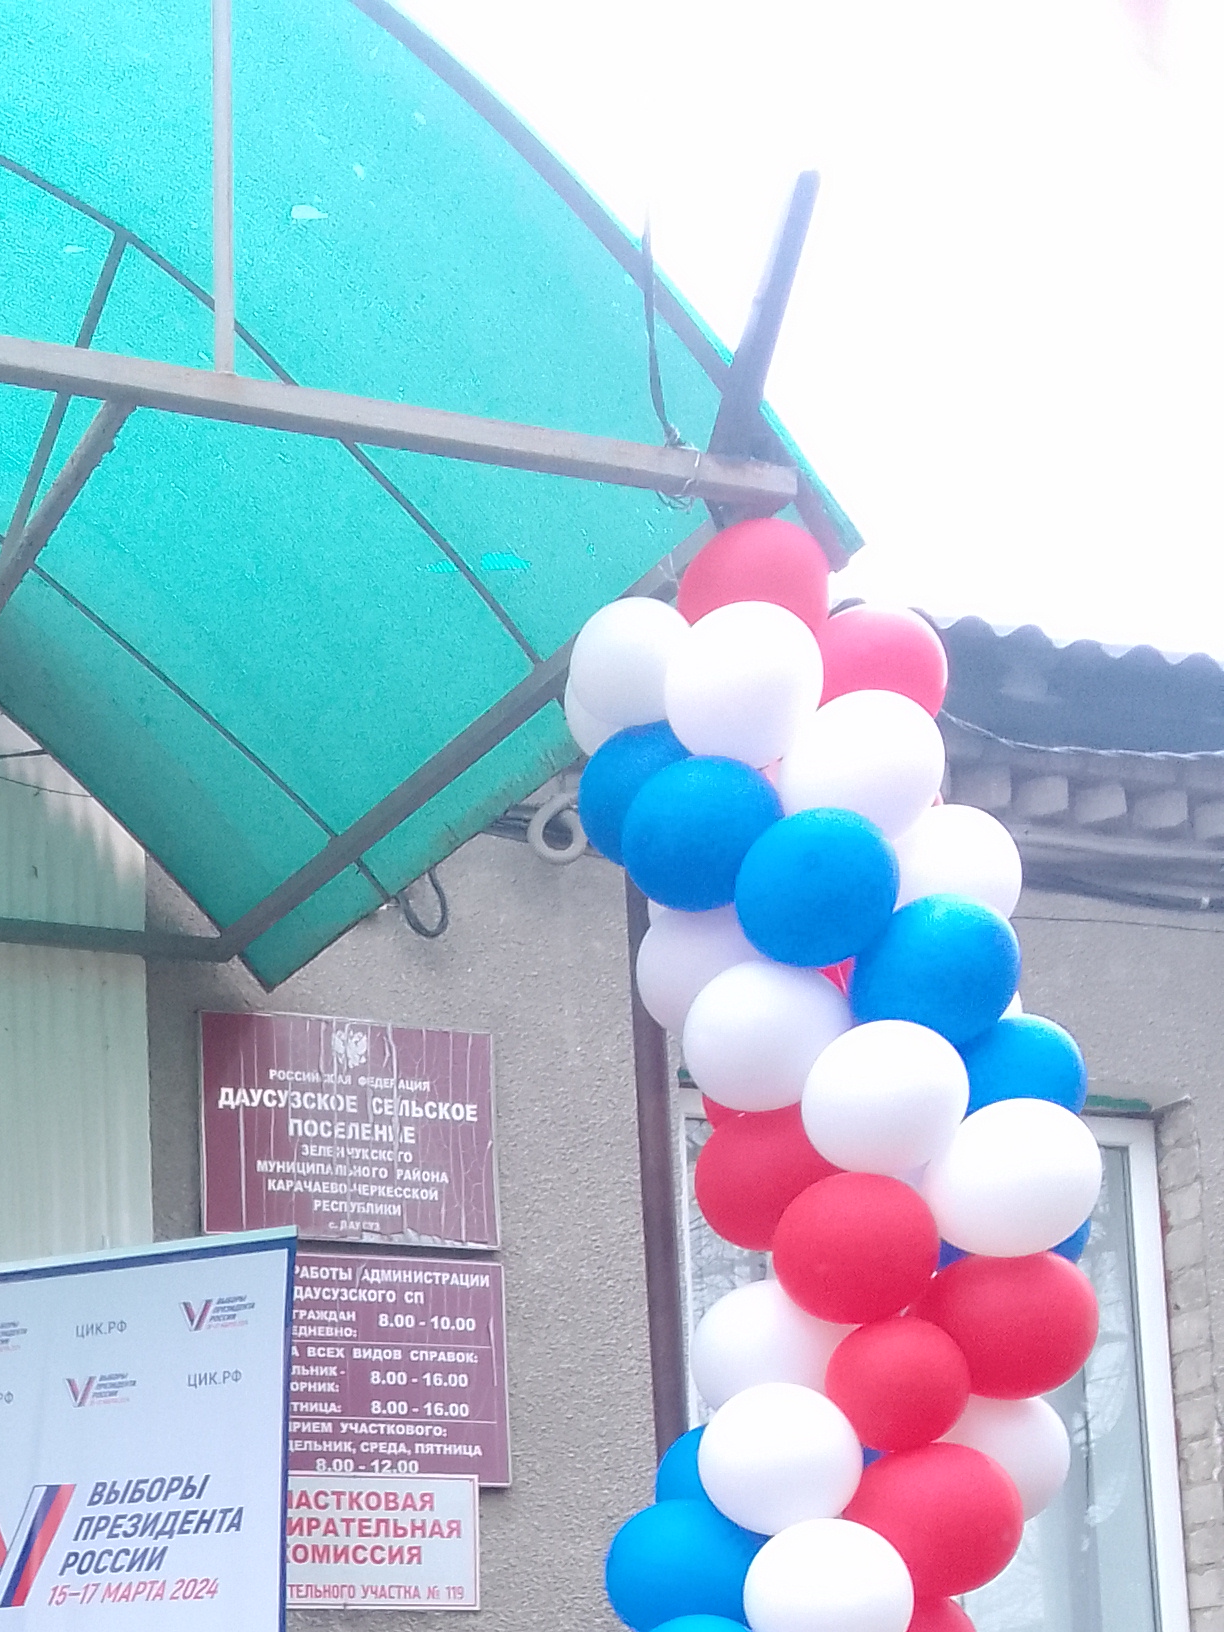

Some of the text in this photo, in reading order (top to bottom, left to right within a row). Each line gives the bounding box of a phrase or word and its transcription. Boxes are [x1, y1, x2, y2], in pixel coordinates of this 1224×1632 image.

[358, 1076, 430, 1092] ФЕДЕРАЦИЯ
[218, 1086, 478, 1122] ДАУСУЗСКОЕ СЕЛЬСКОЕ
[288, 1118, 416, 1144] ПОСЕЛЕНИЕ
[301, 1144, 413, 1163] ЗЕЛЕНЧУКСКОГО
[256, 1160, 450, 1184] МУНИЦИПАЛЬНОГО РАЙОНА
[267, 1179, 439, 1201] КАРАЧАЕВО-ЧЕРКЕССКОЙ
[313, 1199, 402, 1217] РЕСПУБЛИКИ
[361, 1268, 490, 1288] АДМИНИСТРАЦИИ
[293, 1285, 425, 1304] ДАУСУЗСКОГО СП
[292, 1309, 356, 1322] ГРАЖДАН
[378, 1313, 415, 1328] 8.00
[430, 1315, 476, 1331] 10.00
[75, 1321, 127, 1339] ЦИК.РФ
[307, 1346, 345, 1358] ВСЕХ
[352, 1348, 402, 1362] ВИДОВ
[410, 1350, 478, 1364] СПРАВОК:
[187, 1369, 242, 1389] ЦИК.РФ
[370, 1371, 407, 1386] 8.00
[422, 1372, 468, 1387] 16.00
[371, 1401, 408, 1416] 8.00
[423, 1402, 469, 1417] 16.00
[340, 1422, 448, 1437] УЧАСТКОВОГО:
[360, 1441, 412, 1456] СРЕДА,
[414, 1443, 483, 1457] ПЯТНИЦА
[315, 1458, 355, 1473] 8.00
[370, 1459, 419, 1474] 12.00
[86, 1474, 211, 1507] ВЫБОРЫ
[73, 1506, 244, 1541] ПРЕЗИДЕНТА
[59, 1546, 168, 1576] РОССИИ
[286, 1543, 423, 1565] ОМИССИЯ
[101, 1580, 168, 1605] МАРТА
[170, 1577, 220, 1600] 2024
[361, 1585, 421, 1600] УЧАСТКА
[446, 1586, 464, 1600] 119
